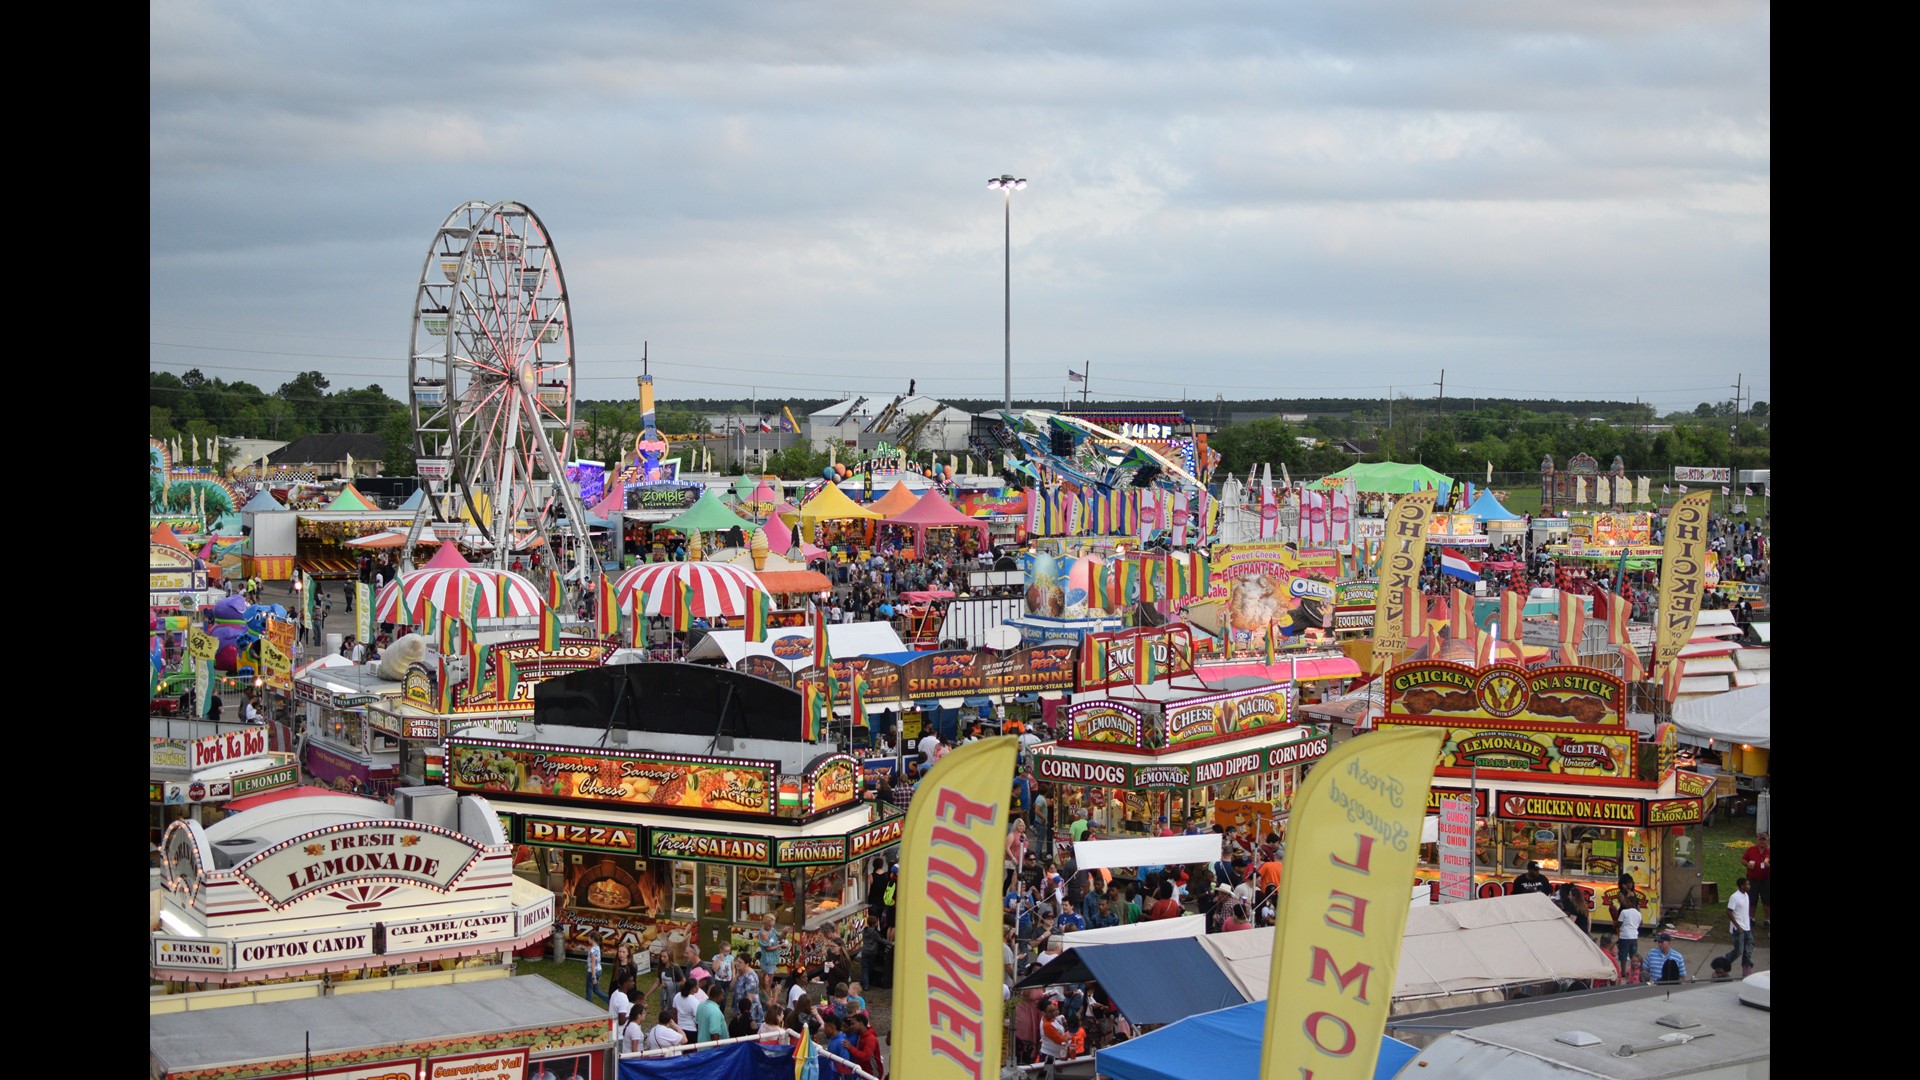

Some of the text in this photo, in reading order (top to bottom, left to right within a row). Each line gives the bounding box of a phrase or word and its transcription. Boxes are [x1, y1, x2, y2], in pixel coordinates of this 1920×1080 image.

[1121, 422, 1172, 438] SURF
[643, 490, 685, 501] ZOMBIE
[1230, 550, 1281, 561] Sweet Cheeks
[1221, 562, 1290, 584] ELEPHANT EARS
[1207, 582, 1228, 599] Cake
[1291, 578, 1334, 598] OREO
[1344, 590, 1375, 600] LEMONADE
[1338, 615, 1373, 627] FOOT LONG
[774, 646, 799, 656] BEEF
[1031, 650, 1046, 659] BIG
[933, 656, 948, 665] BIG
[1031, 658, 1056, 669] BEEF
[932, 664, 959, 675] BEEF
[870, 674, 898, 688] TIP
[909, 677, 981, 691] SIRLOIN
[986, 674, 1015, 686] TIP
[1395, 669, 1616, 701] CHICKEN ON A STICK
[909, 691, 936, 699] SAUTEED
[936, 689, 975, 697] MUSHROOMS
[411, 719, 438, 728] CHEESE
[1172, 698, 1275, 733] CHEESE NACHOS
[411, 727, 438, 737] FRIES
[503, 720, 517, 733] DOG
[1087, 716, 1135, 738] LEMONADE
[1183, 725, 1214, 738] ON-A-STICK
[196, 731, 265, 766] Pork Ka Bob
[1269, 738, 1327, 767] CORN DOGS
[1463, 738, 1607, 757] LEMONADE ICED TEA
[533, 753, 679, 785] Pepperoni Sausage
[1041, 759, 1126, 785] CORN DOGS
[1196, 754, 1260, 782] HAND DIPPED
[1475, 758, 1529, 769] SHAKE-UPS
[239, 770, 293, 792] LEMONADE
[460, 760, 486, 773] Fresh
[579, 776, 628, 797] Cheese
[1134, 769, 1190, 786] LEMONADE
[461, 771, 764, 808] SALADS NACHOS
[1426, 792, 1457, 807] RIES
[1446, 811, 1469, 824] GUMBO
[1526, 797, 1636, 821] CHICKEN ON A STICK
[1650, 808, 1700, 823] LEMONADE
[330, 833, 396, 852] FRESH
[532, 822, 632, 848] PIZZA
[852, 820, 901, 855] PIZZA
[1446, 835, 1467, 848] ONION
[656, 834, 767, 860] Fresh SALADS
[779, 844, 843, 862] LEMONADE
[1628, 846, 1646, 854] ICED
[1628, 854, 1645, 863] TEA
[287, 851, 441, 892] LEMONADE
[523, 904, 552, 929] DRINKS
[567, 911, 647, 931] Pepperoni Cheese
[390, 914, 510, 938] CARAMEL/CANDY
[563, 923, 643, 947] IZZA
[172, 943, 211, 955] FRESH
[242, 930, 479, 963] COTTON CANDY APPLES
[160, 953, 224, 966] LEMONADE
[434, 1056, 523, 1079] Guaranteed Yall
